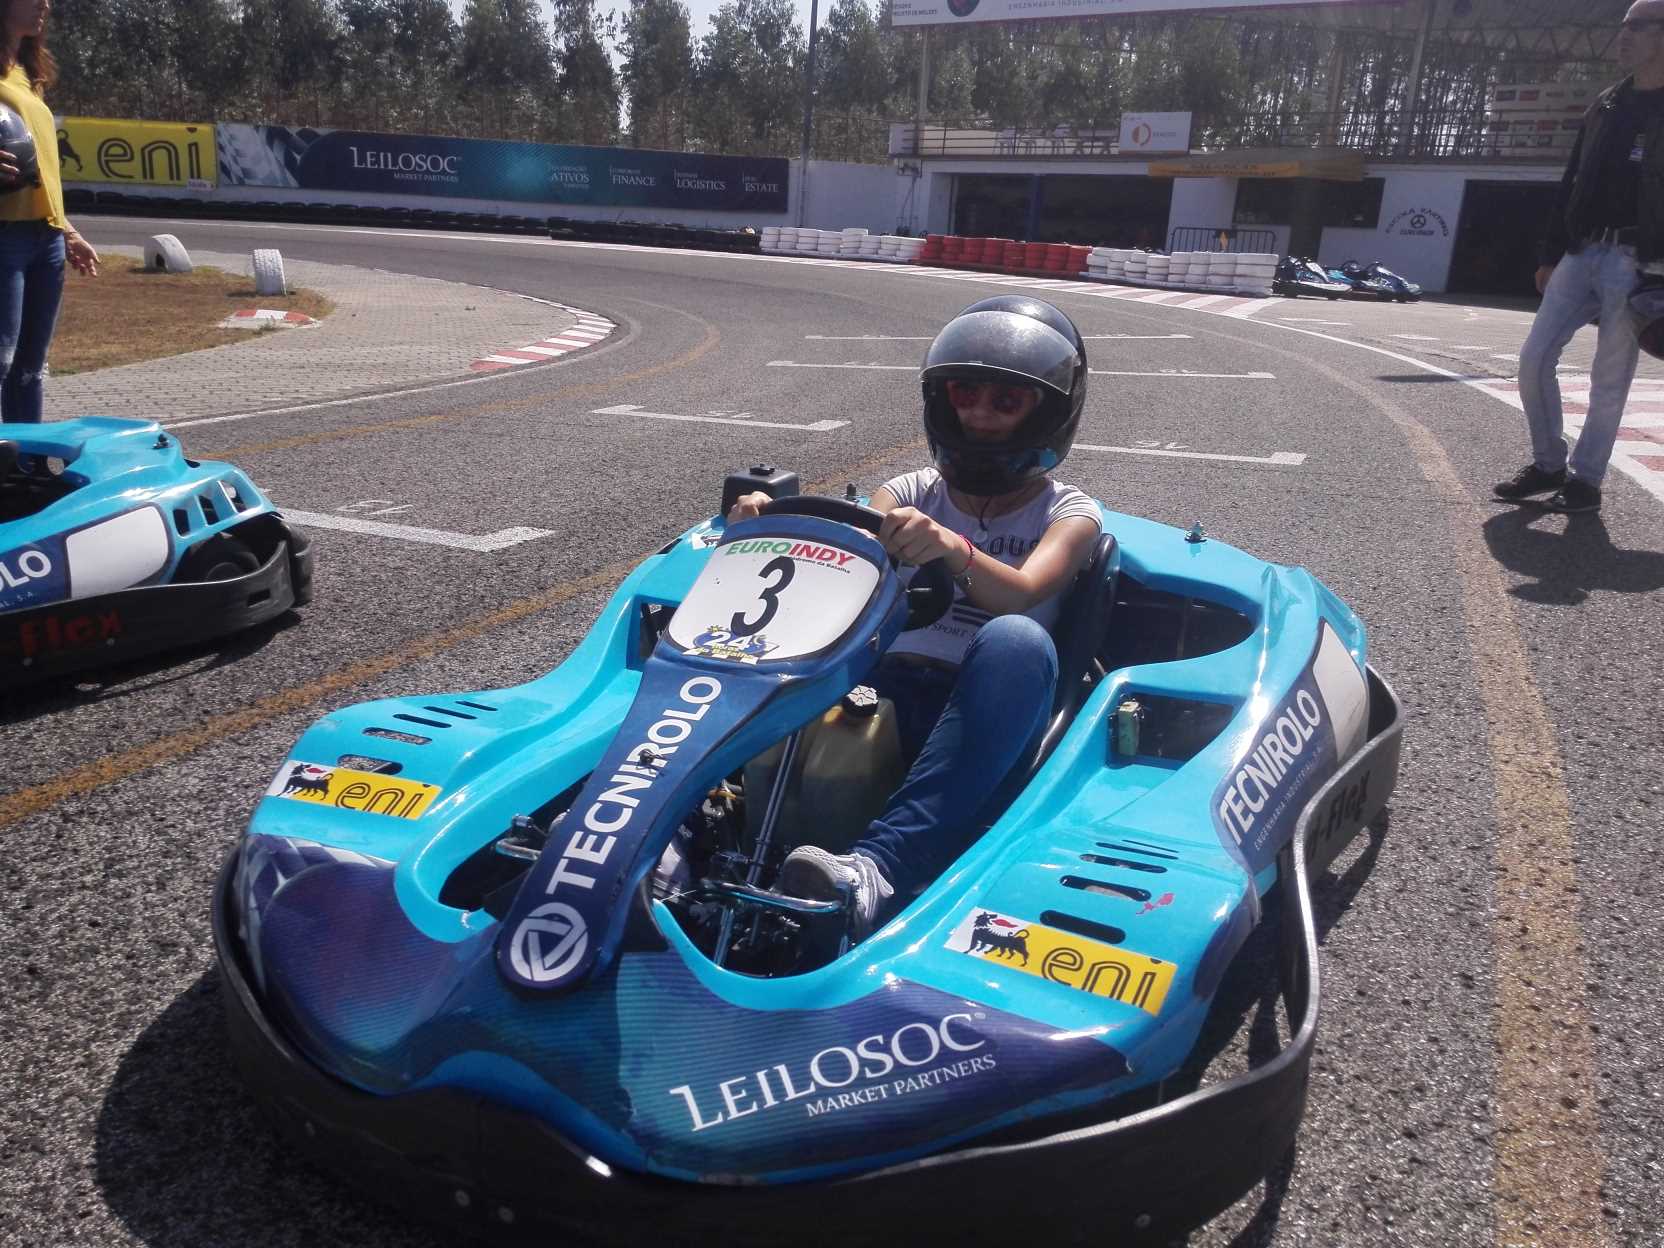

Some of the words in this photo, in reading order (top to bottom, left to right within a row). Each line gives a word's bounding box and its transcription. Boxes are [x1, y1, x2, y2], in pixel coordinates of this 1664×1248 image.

[96, 127, 200, 181] eni
[350, 146, 457, 174] LEILOSOC
[551, 172, 590, 184] ATIVOS
[612, 174, 656, 186] FINANCE
[676, 178, 726, 191] LOGISTICS
[745, 182, 779, 192] ESTATE
[0, 550, 52, 592] LO
[726, 539, 857, 567] EUROINDY
[731, 556, 796, 637] 3
[703, 631, 753, 651] 24
[545, 675, 723, 895] TECNIROLO
[1219, 689, 1321, 845] TECNIROLO
[335, 781, 432, 819] eni
[1041, 946, 1163, 1009] eni
[669, 1012, 986, 1132] LEILOSOC
[805, 1083, 890, 1118] MARKET
[894, 1053, 997, 1096] PARTNERS
